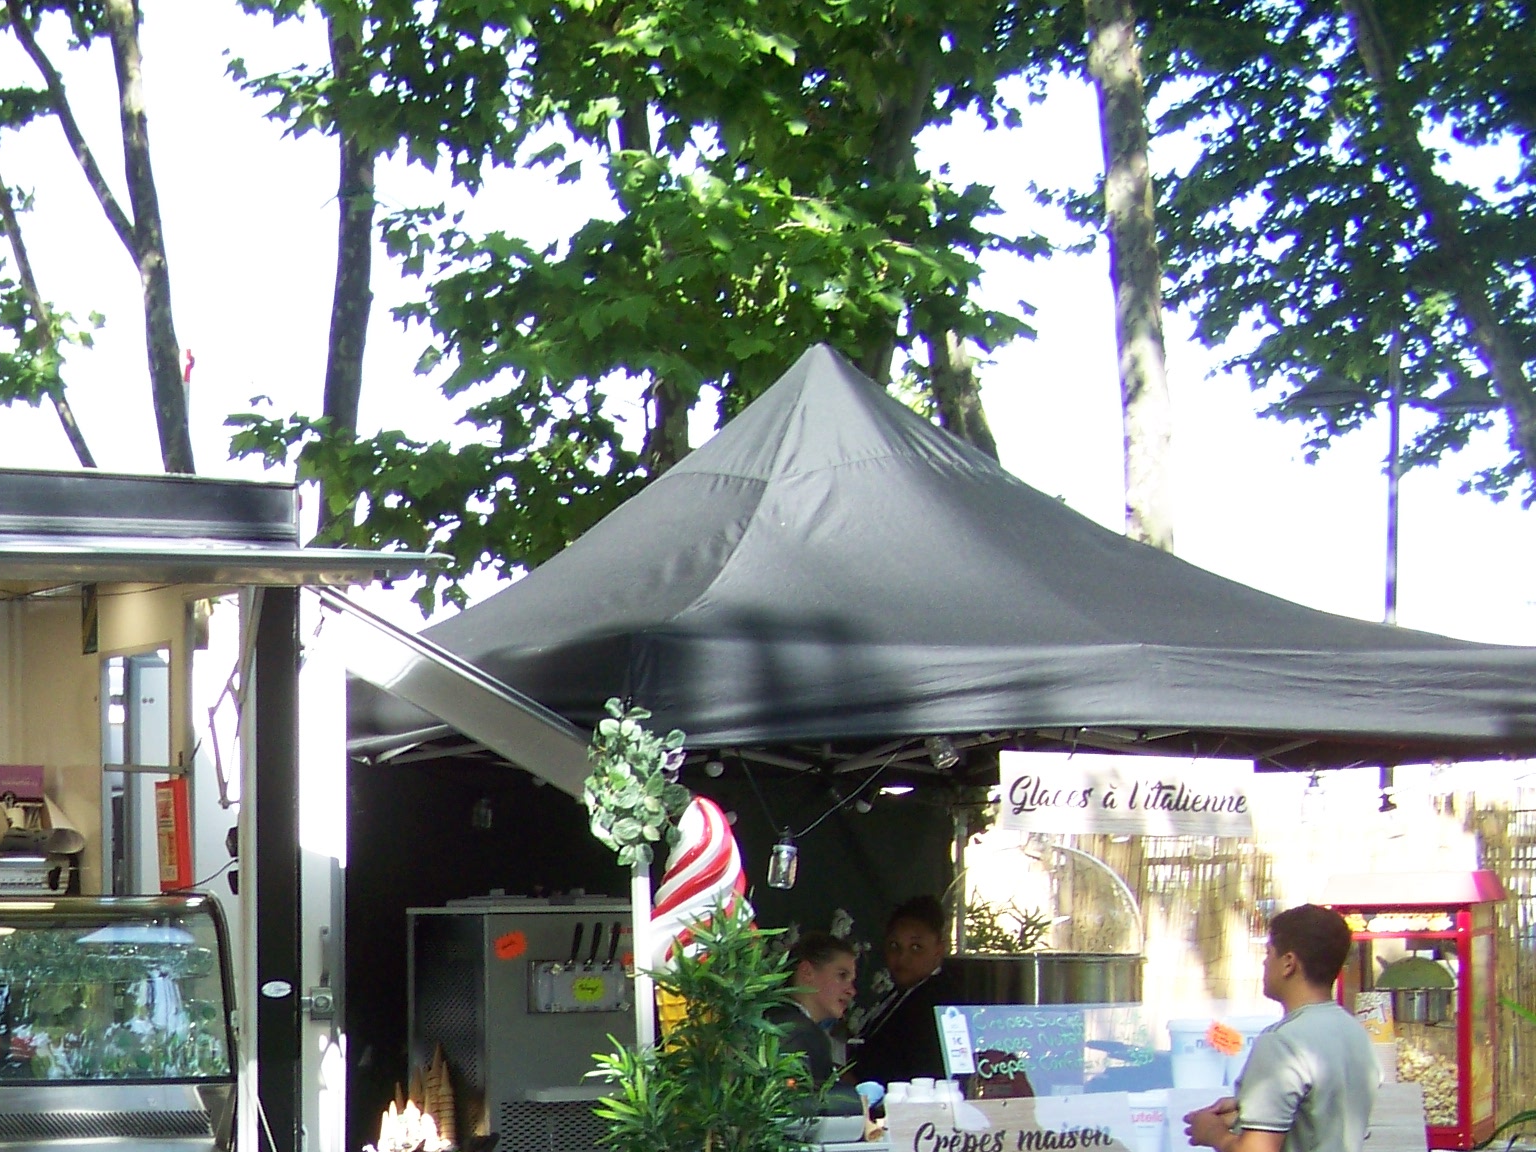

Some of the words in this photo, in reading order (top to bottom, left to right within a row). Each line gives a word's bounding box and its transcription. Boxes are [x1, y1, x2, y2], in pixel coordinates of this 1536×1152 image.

[1009, 775, 1094, 816] Glaces
[1128, 780, 1249, 815] l'italienne
[1017, 1120, 1114, 1151] maison
